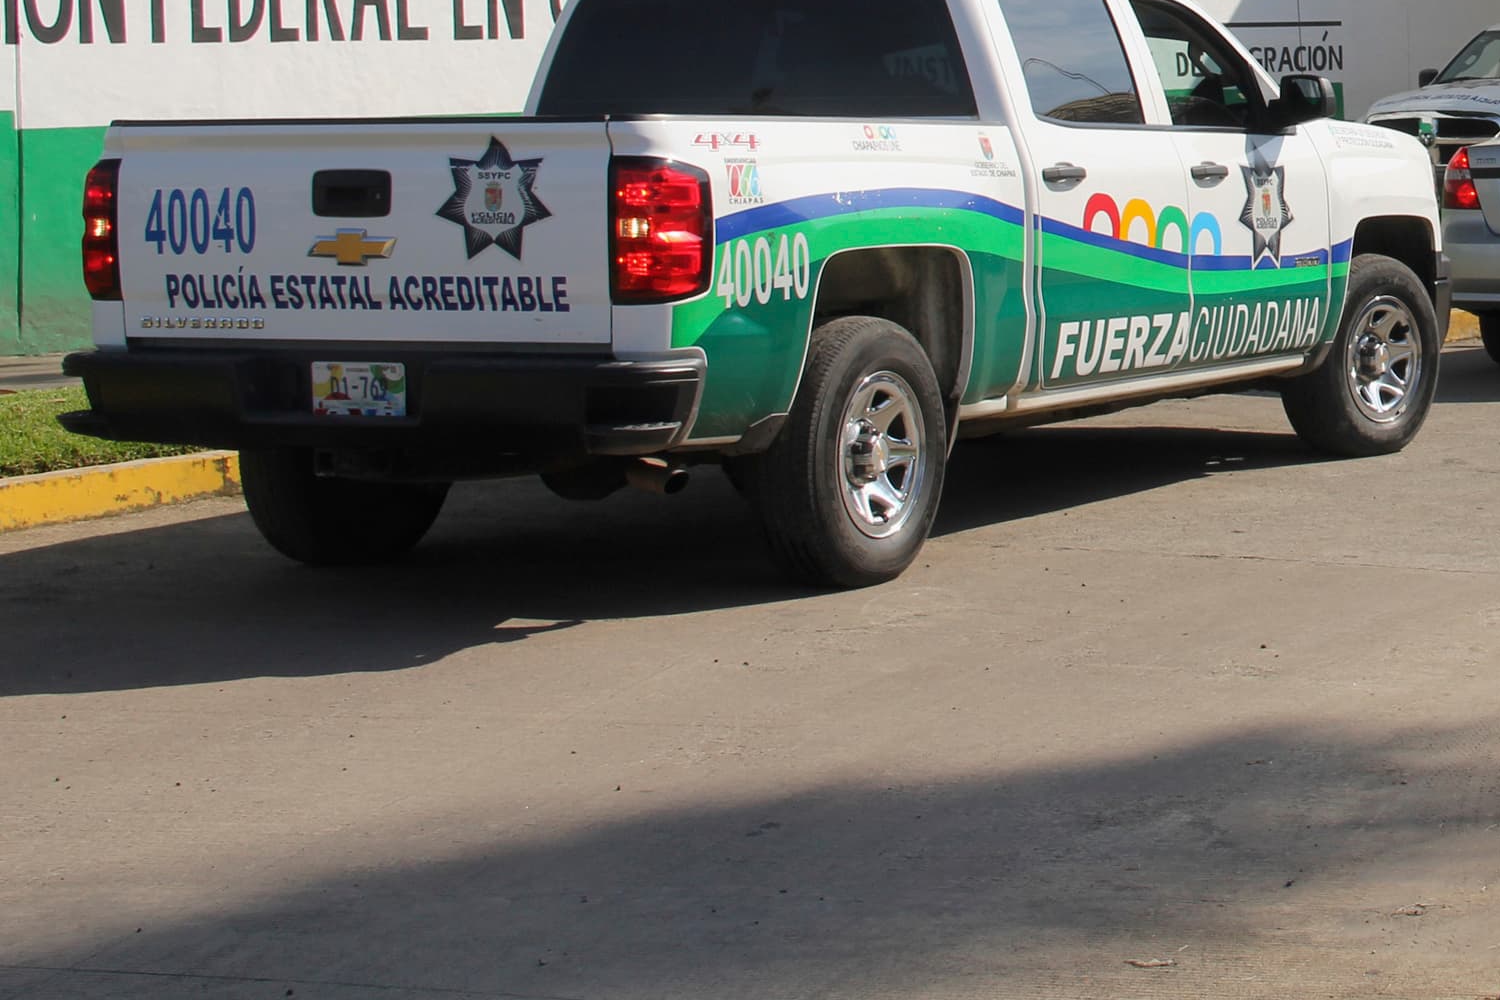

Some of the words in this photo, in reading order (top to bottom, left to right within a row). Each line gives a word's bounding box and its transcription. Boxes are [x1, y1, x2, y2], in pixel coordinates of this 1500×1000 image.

[1250, 30, 1343, 72] GRACIÓN
[145, 187, 256, 254] 40040
[166, 266, 266, 309] POLICÍA
[270, 275, 382, 310] ESTATAL
[388, 276, 570, 312] ACREDITABLE
[717, 232, 810, 309] 40040
[141, 316, 264, 329] SILVERADO
[1051, 311, 1190, 379] FUERZA
[1189, 296, 1320, 362] CIUDADANA
